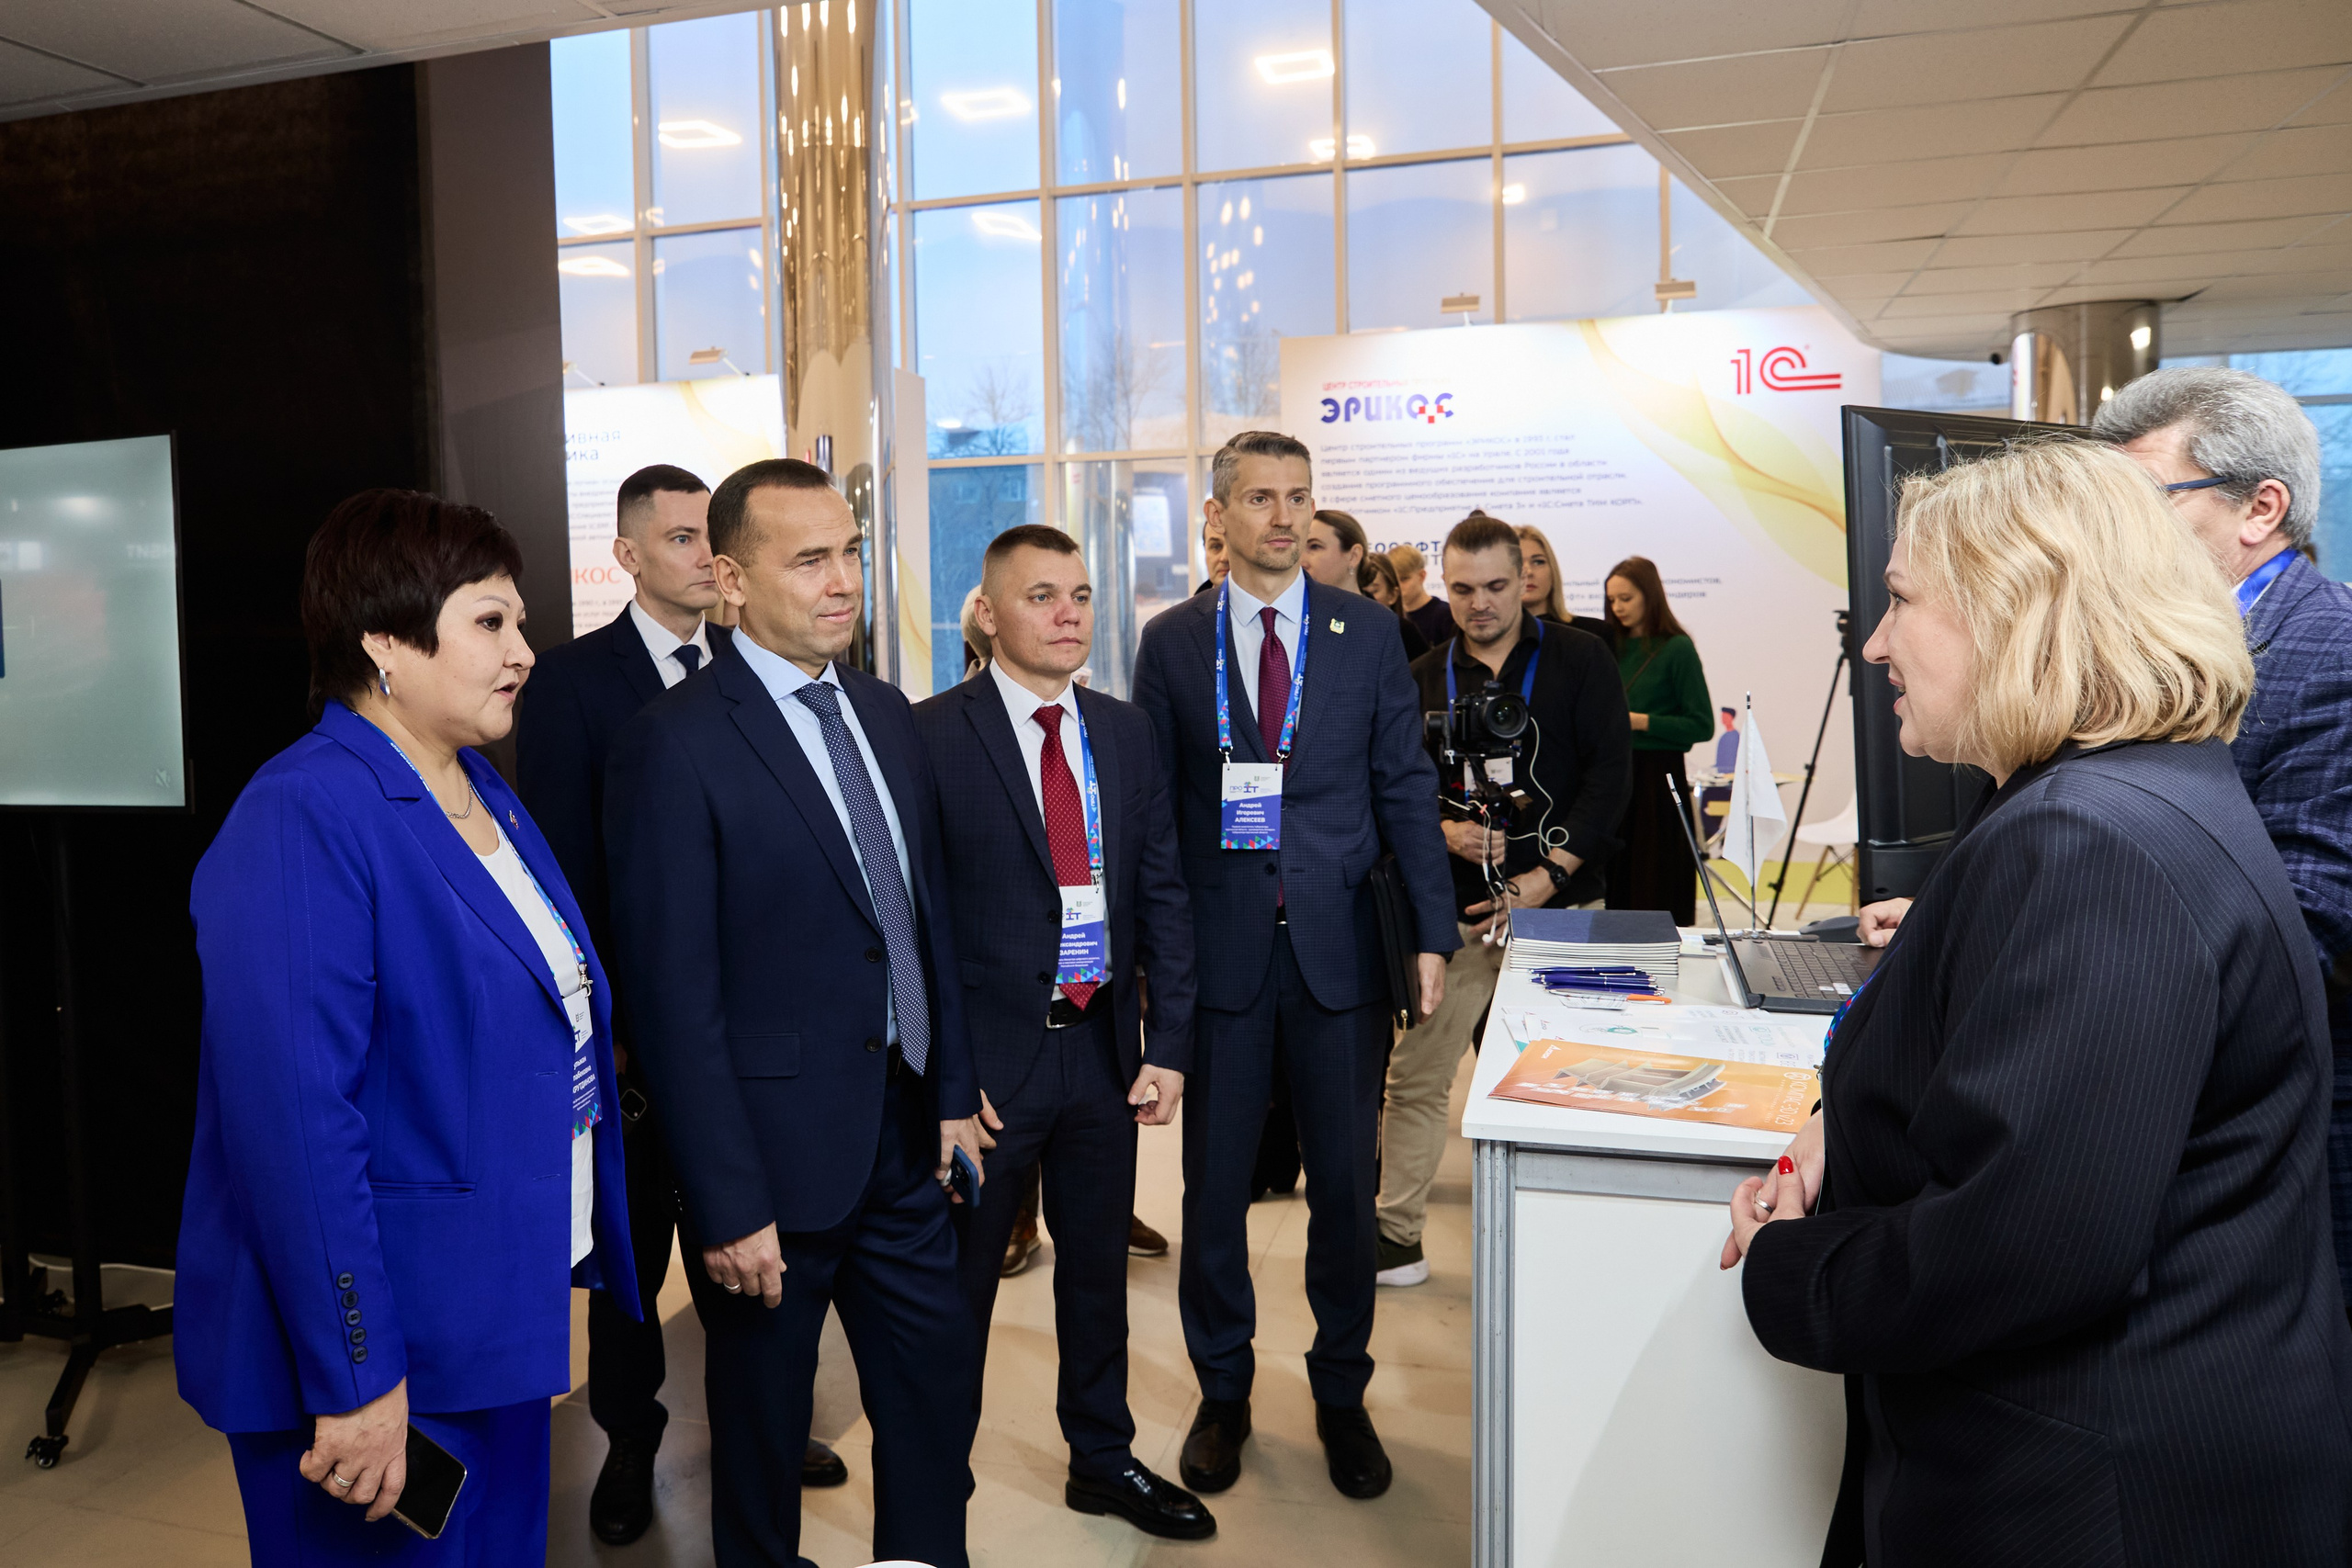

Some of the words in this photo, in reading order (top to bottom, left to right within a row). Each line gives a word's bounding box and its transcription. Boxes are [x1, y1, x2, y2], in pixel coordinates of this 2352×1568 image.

[1320, 392, 1454, 423] ЭРИКОС
[571, 567, 622, 585] КОС
[1062, 931, 1086, 940] Андрей
